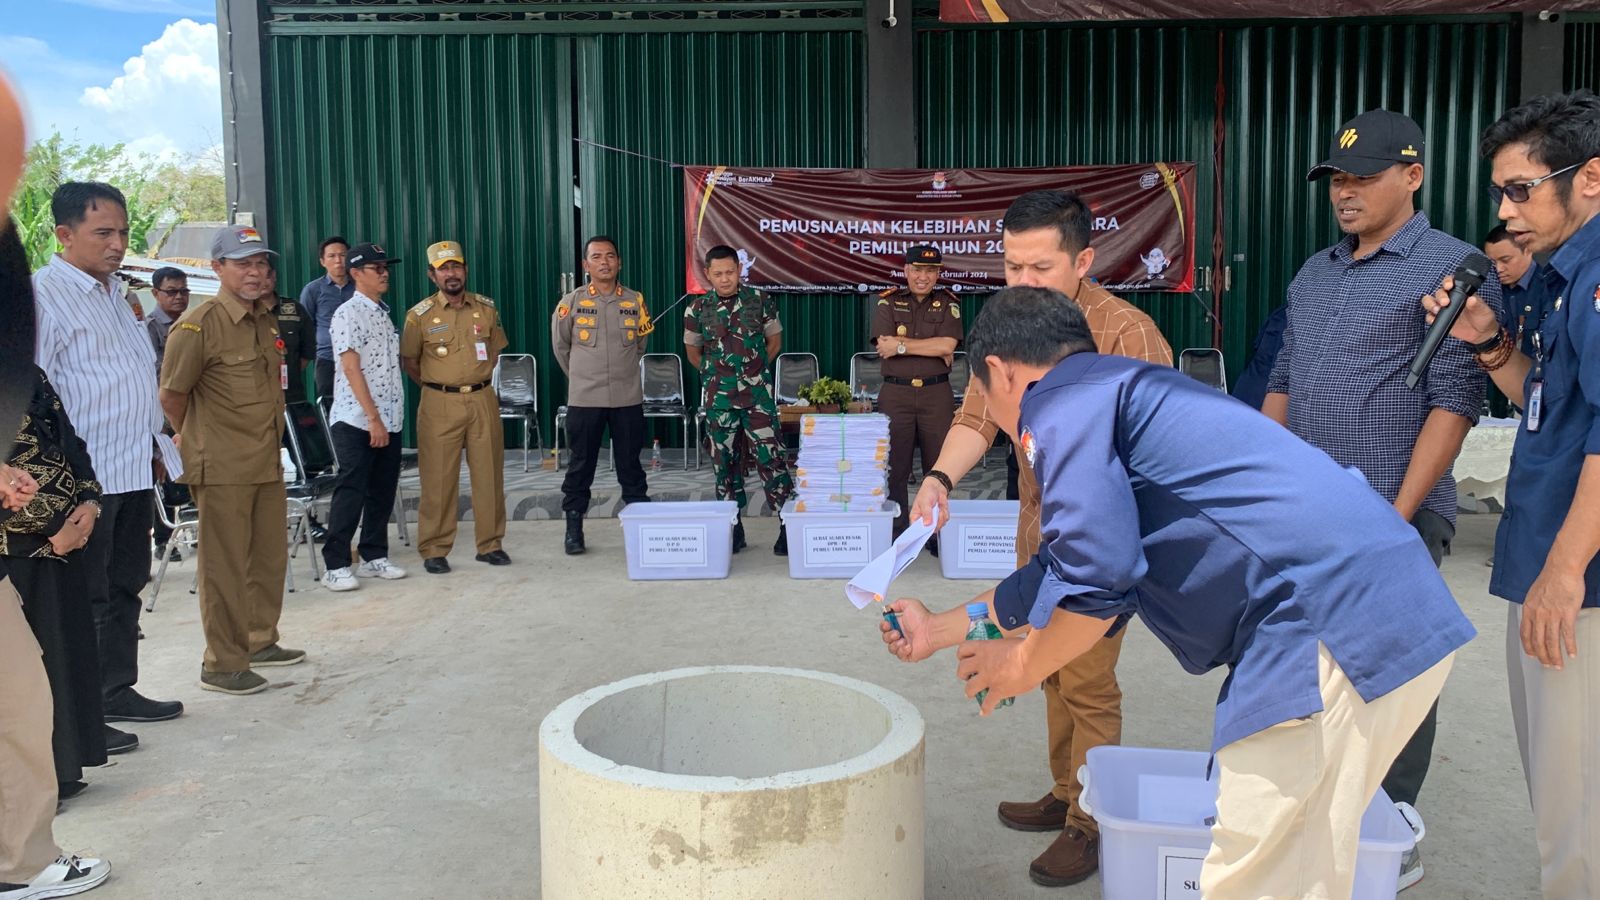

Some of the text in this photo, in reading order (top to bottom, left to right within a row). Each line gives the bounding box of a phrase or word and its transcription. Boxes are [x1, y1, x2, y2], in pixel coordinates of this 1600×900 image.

[759, 218, 885, 234] PEMUSNAHAN
[891, 220, 990, 234] KELEBIHAN
[985, 240, 1005, 254] 20
[938, 270, 988, 279] ebruari 2024
